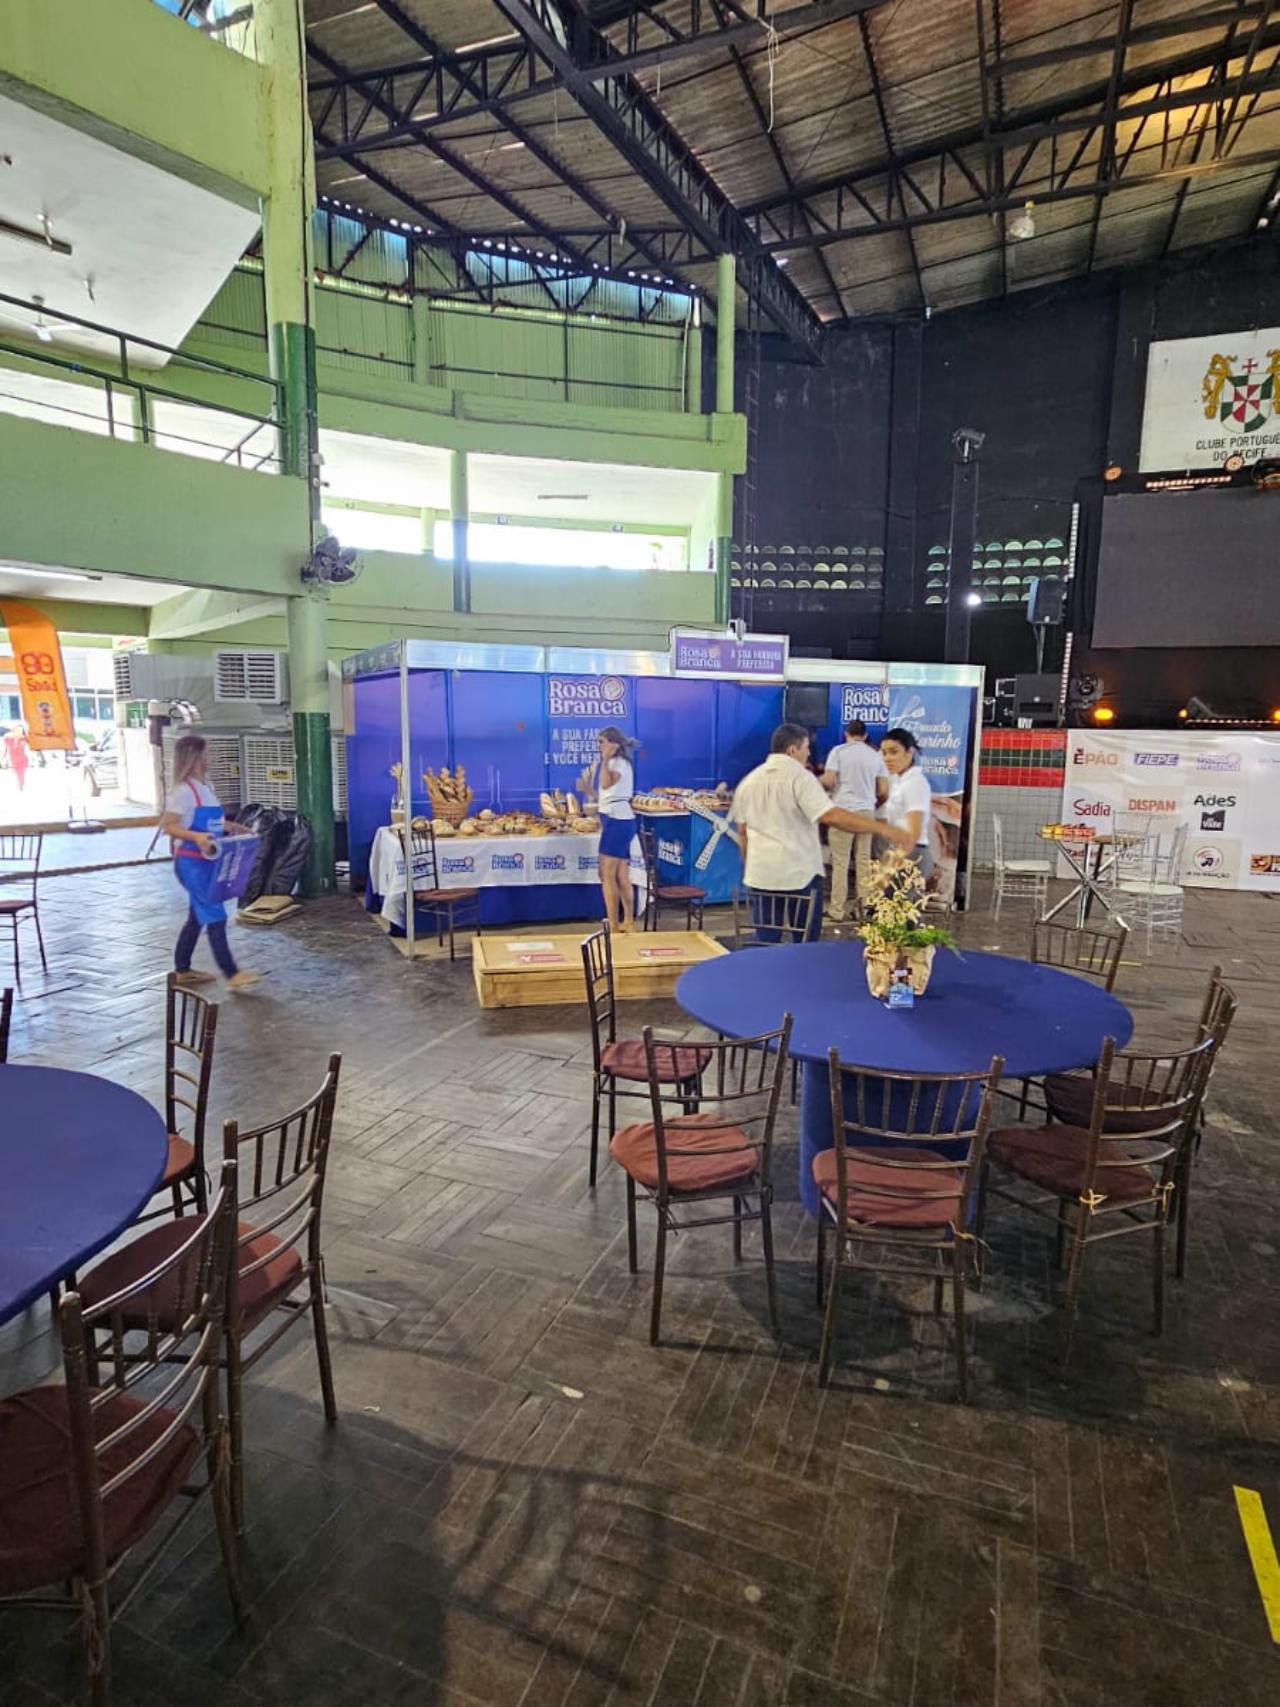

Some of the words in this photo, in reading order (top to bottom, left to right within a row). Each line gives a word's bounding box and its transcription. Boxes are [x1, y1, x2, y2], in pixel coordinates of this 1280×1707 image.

[1196, 439, 1228, 449] CLUBE
[1213, 451, 1228, 461] DO
[680, 646, 707, 658] Rosa
[680, 657, 721, 668] Branca
[549, 680, 601, 699] Rosa
[844, 689, 880, 706] Rosa
[549, 698, 625, 715] Branca
[844, 705, 889, 721] Branc
[1136, 754, 1178, 766] FIEPE
[1129, 800, 1176, 811] DISPAN
[1194, 794, 1237, 807] AdeS
[1073, 799, 1111, 816] Sadia
